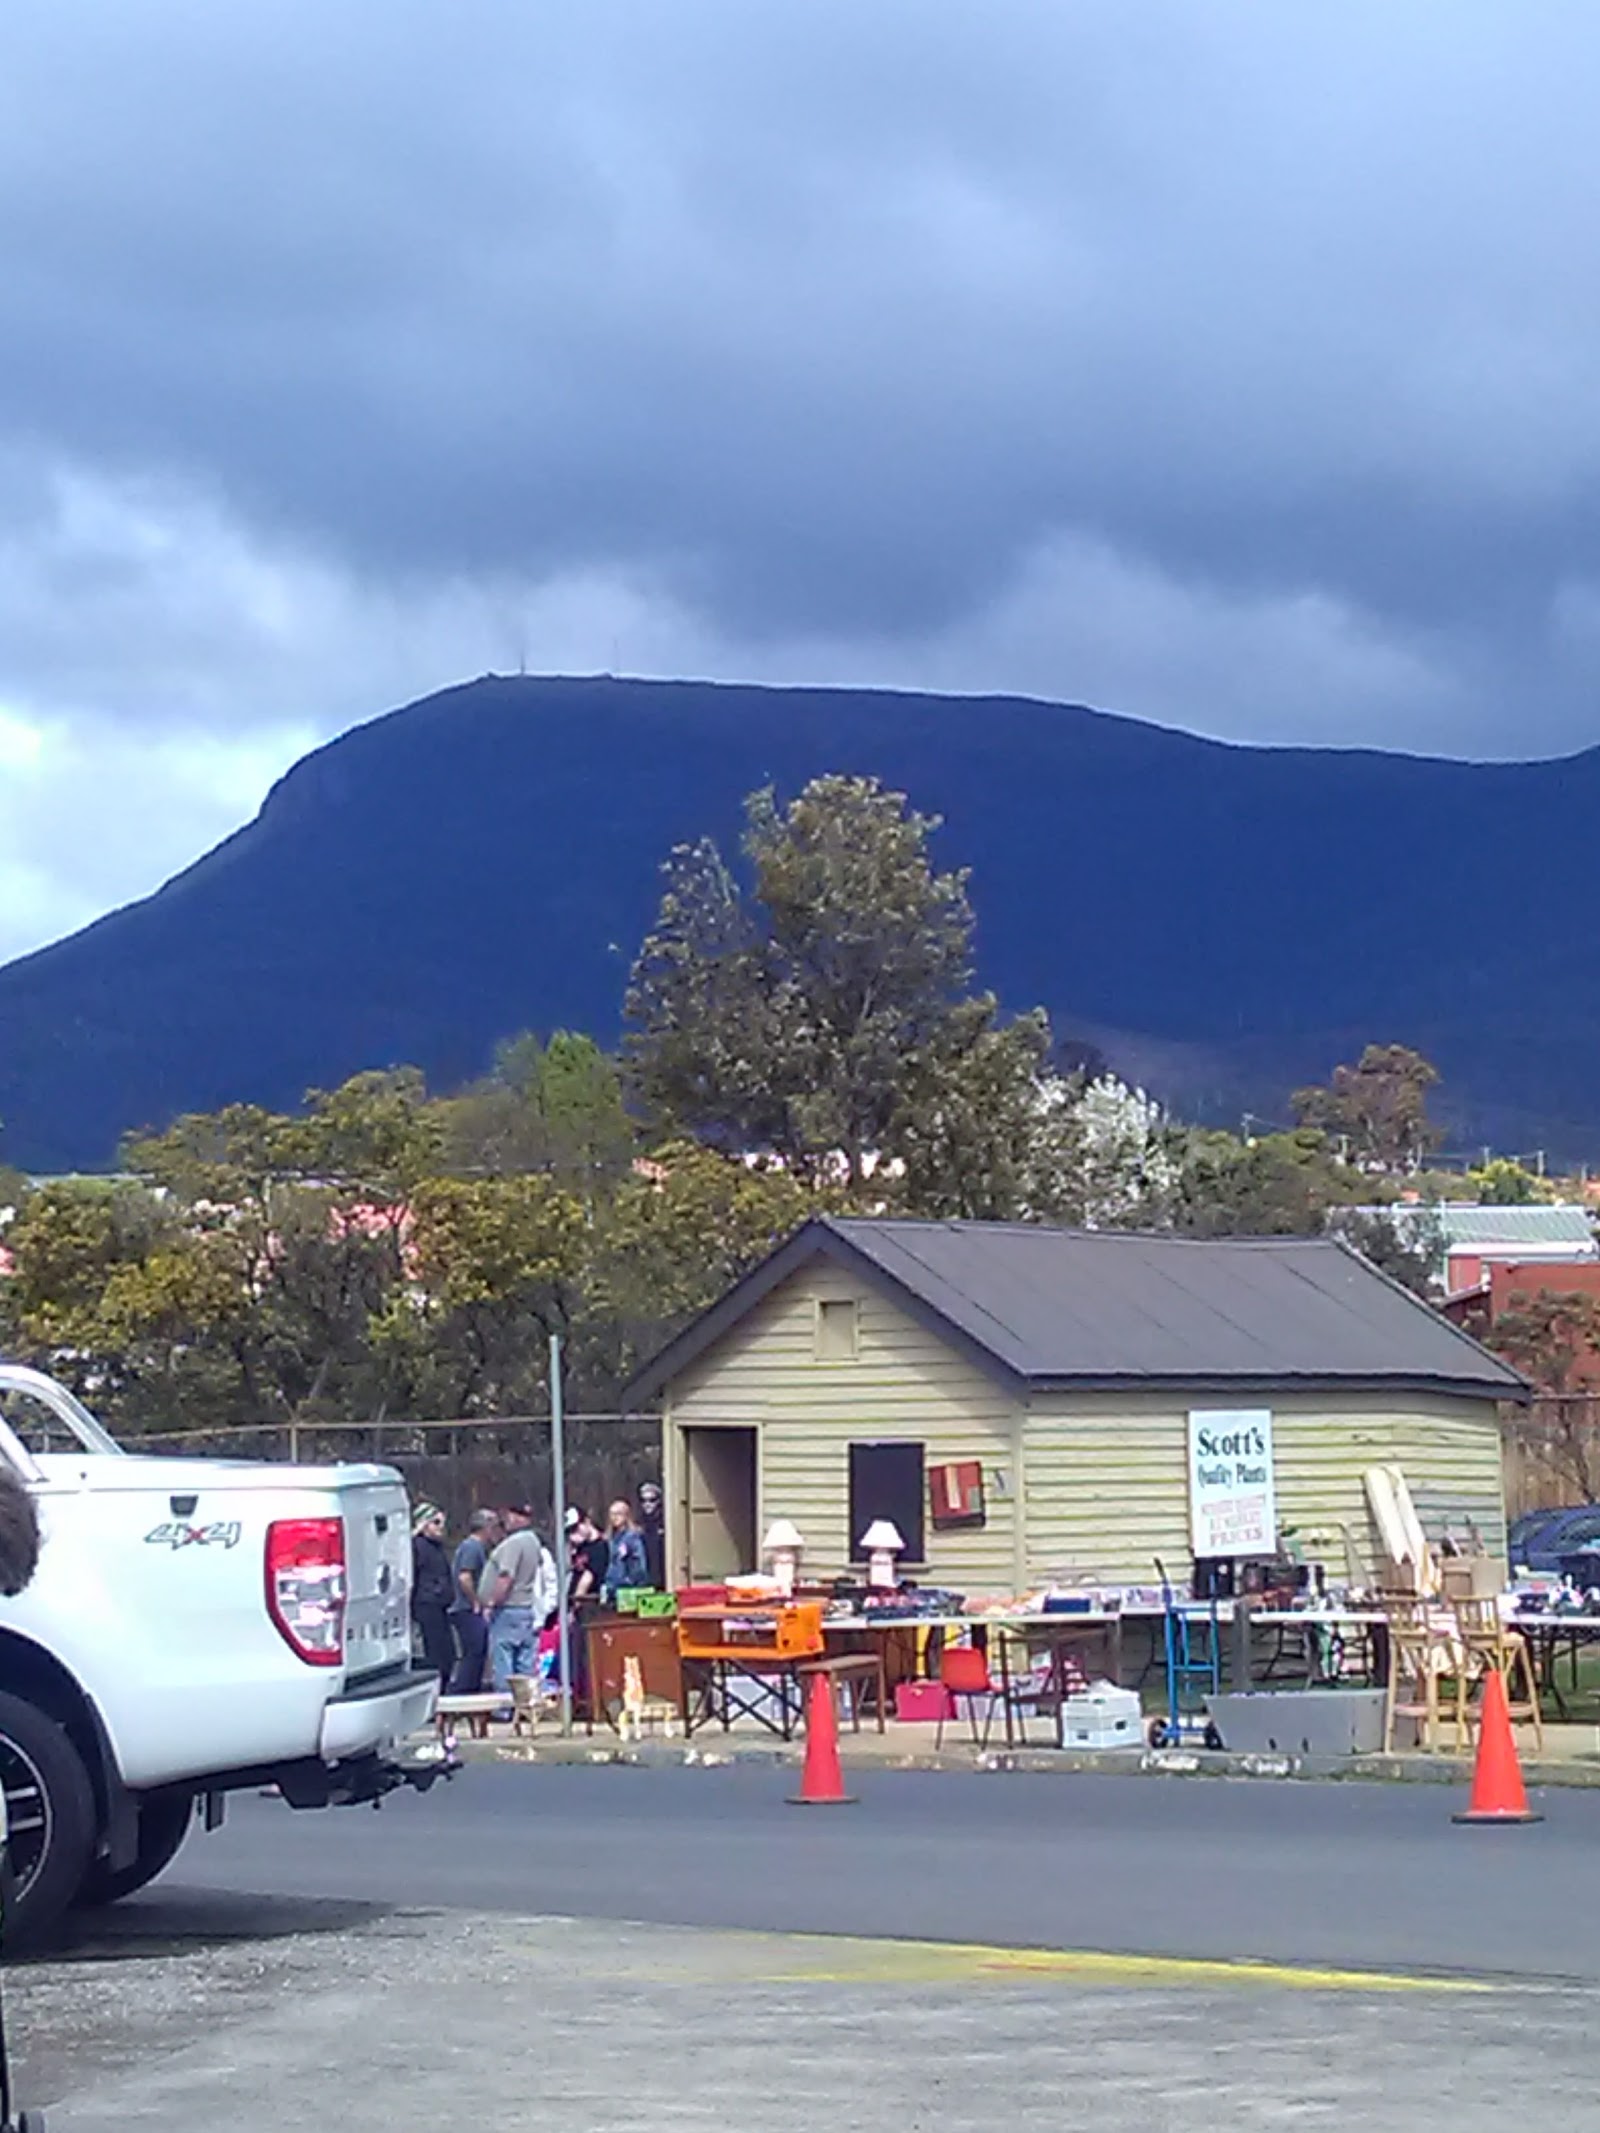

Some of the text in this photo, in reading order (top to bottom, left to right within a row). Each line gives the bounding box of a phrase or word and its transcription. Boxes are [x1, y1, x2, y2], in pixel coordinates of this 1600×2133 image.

[1197, 1426, 1265, 1457] Scott's
[1198, 1462, 1266, 1489] Quality Plants
